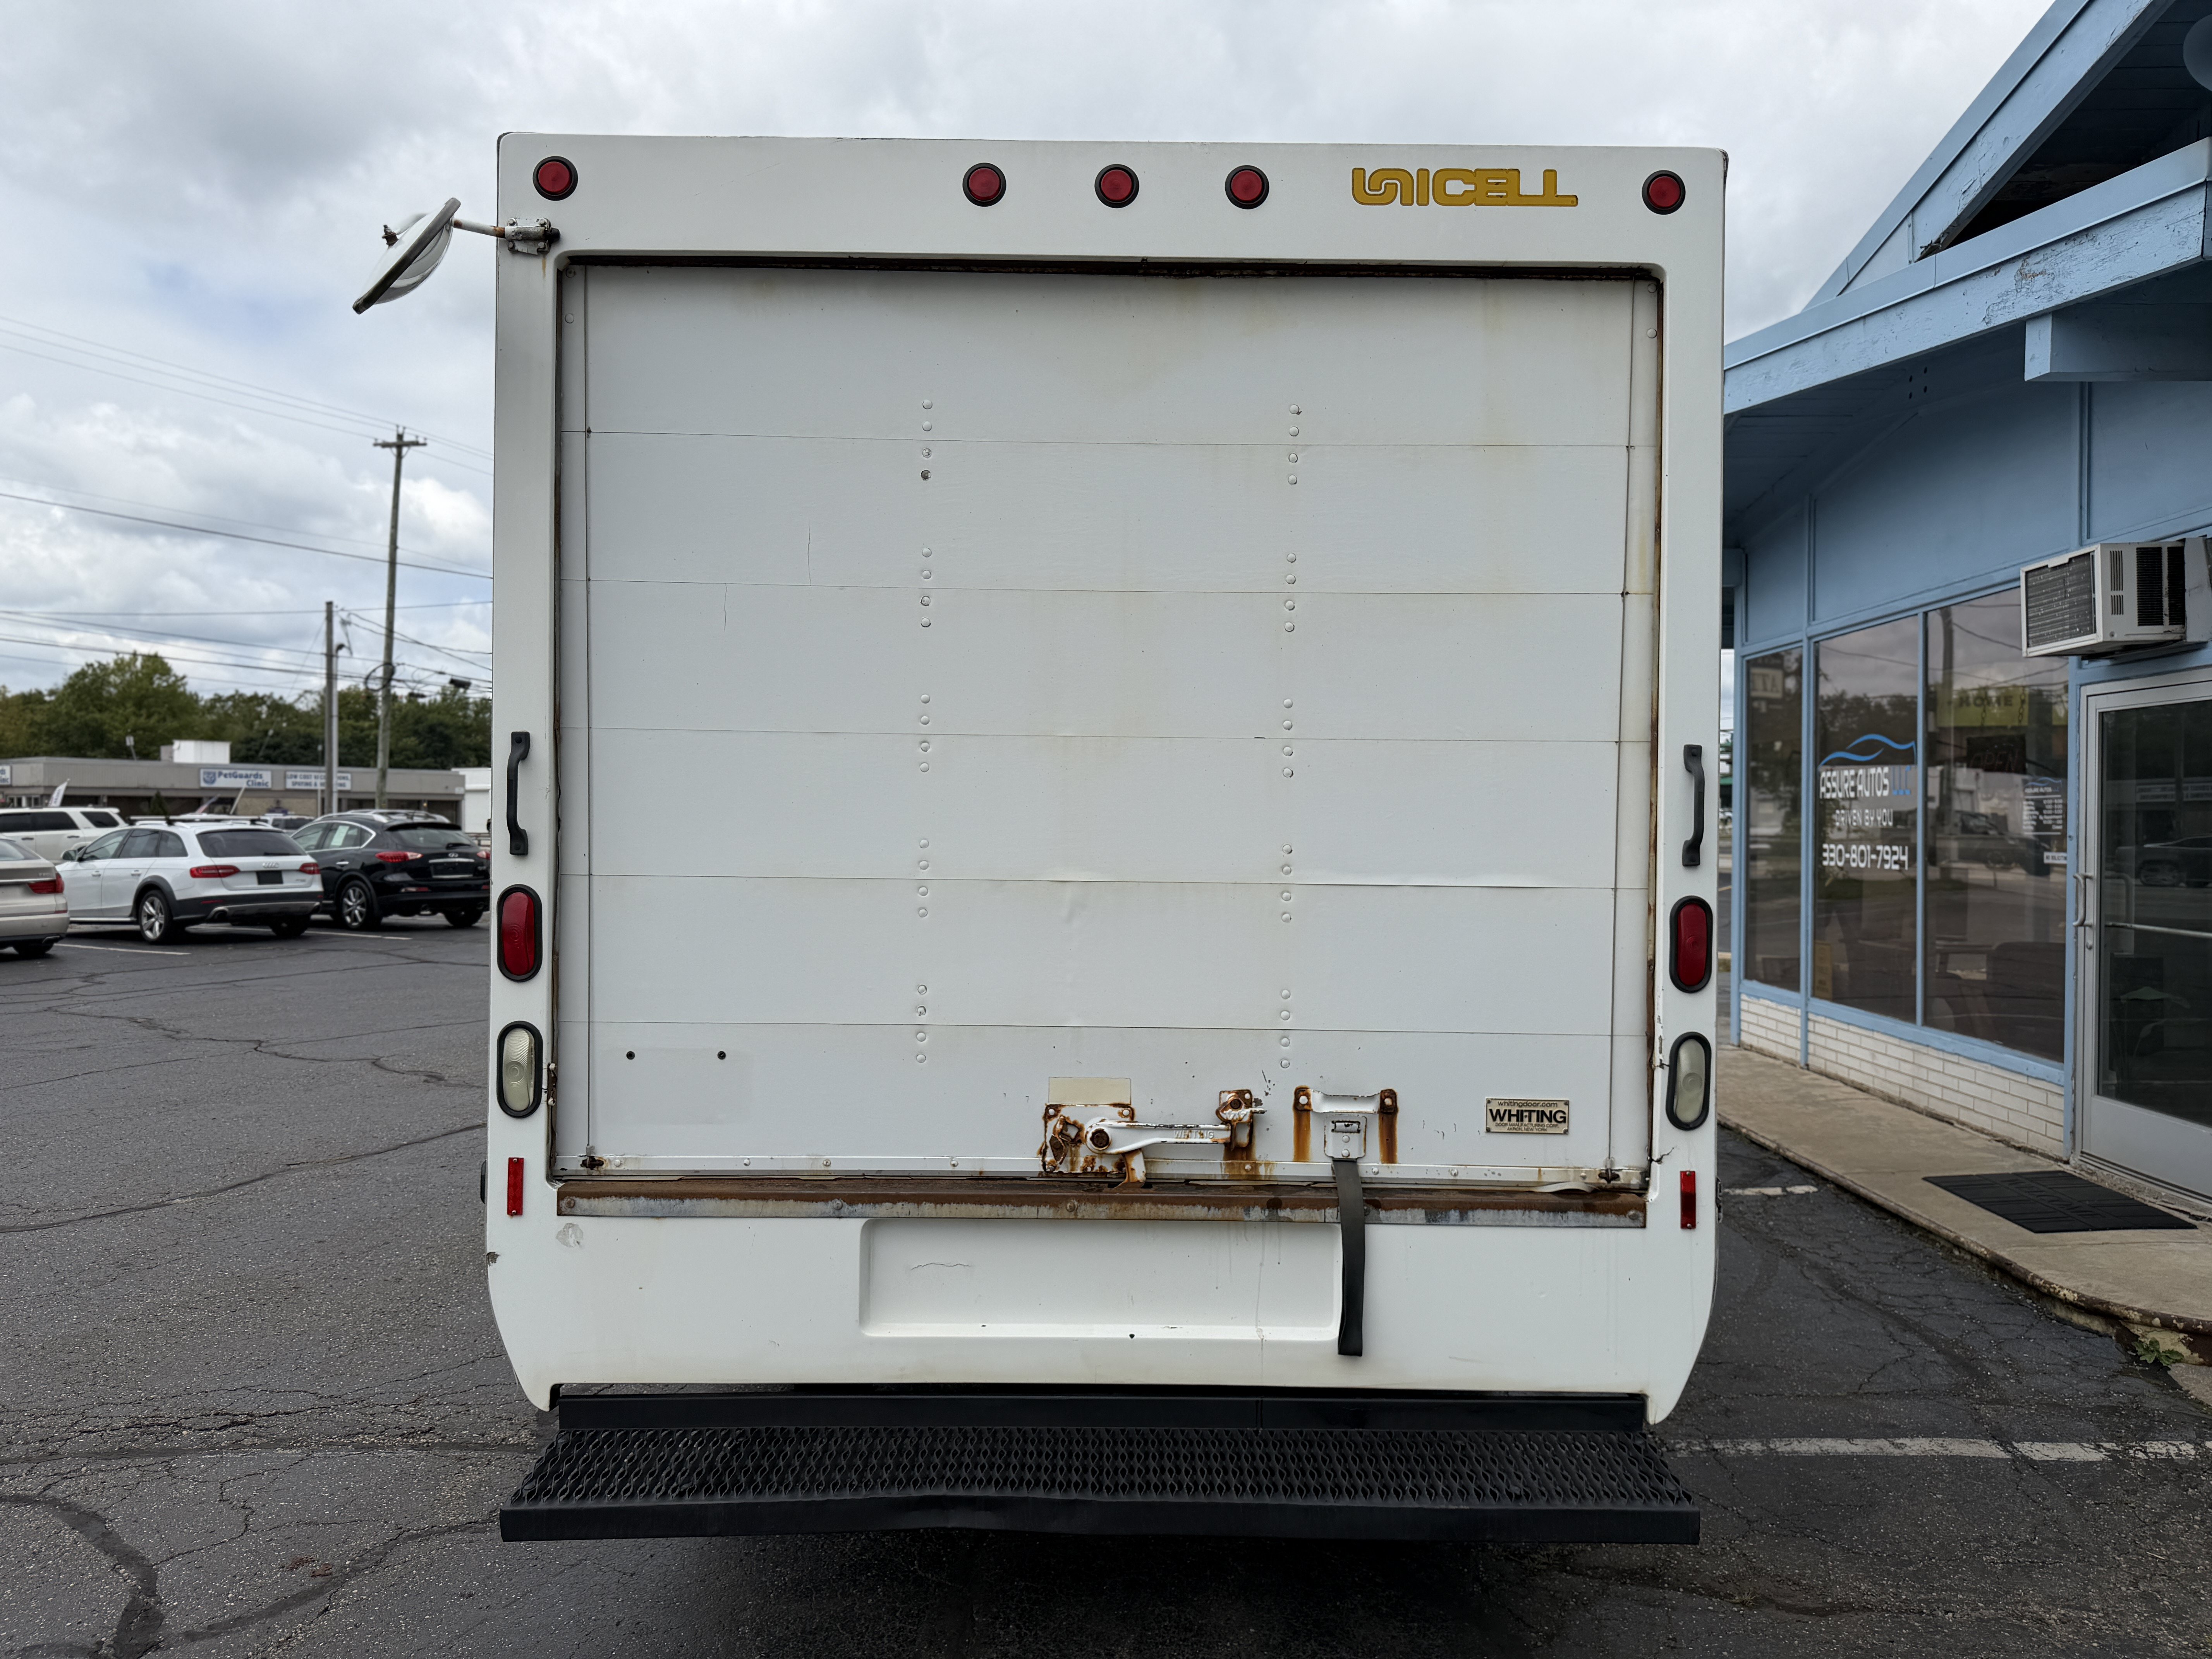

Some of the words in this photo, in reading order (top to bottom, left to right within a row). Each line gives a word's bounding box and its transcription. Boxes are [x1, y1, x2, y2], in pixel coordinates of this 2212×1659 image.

[1352, 168, 1578, 206] UNICELL
[1820, 769, 1855, 799] ASSURE
[1856, 766, 1890, 797] AUTOS
[1891, 765, 1911, 796] LLC
[1835, 809, 1862, 826] DRIVEN
[1865, 809, 1875, 826] BY
[1876, 809, 1893, 826] YOU
[1822, 843, 1908, 871] 330-801-7924
